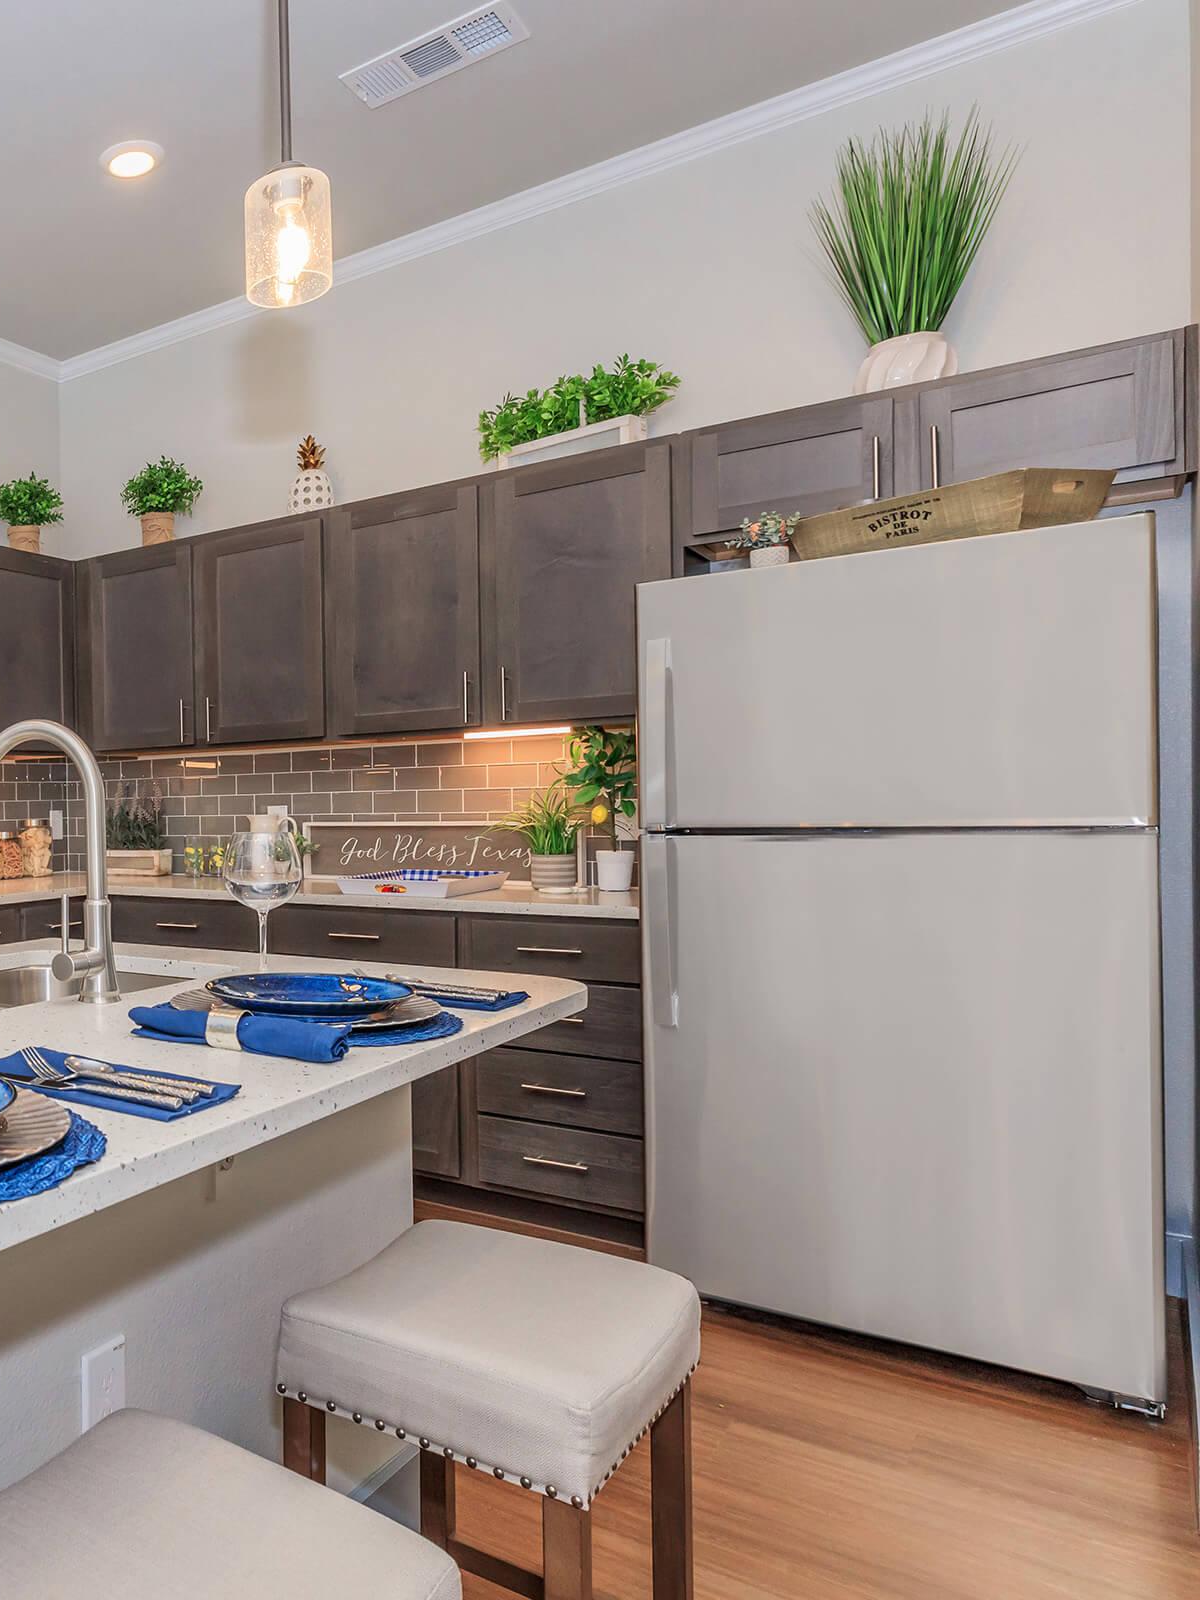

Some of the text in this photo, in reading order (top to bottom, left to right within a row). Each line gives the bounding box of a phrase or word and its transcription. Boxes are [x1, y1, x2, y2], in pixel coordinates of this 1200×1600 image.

[868, 510, 932, 533] BISTROT
[893, 521, 908, 530] DE
[885, 526, 920, 539] PARIS
[340, 833, 532, 867] God Bless Texas
